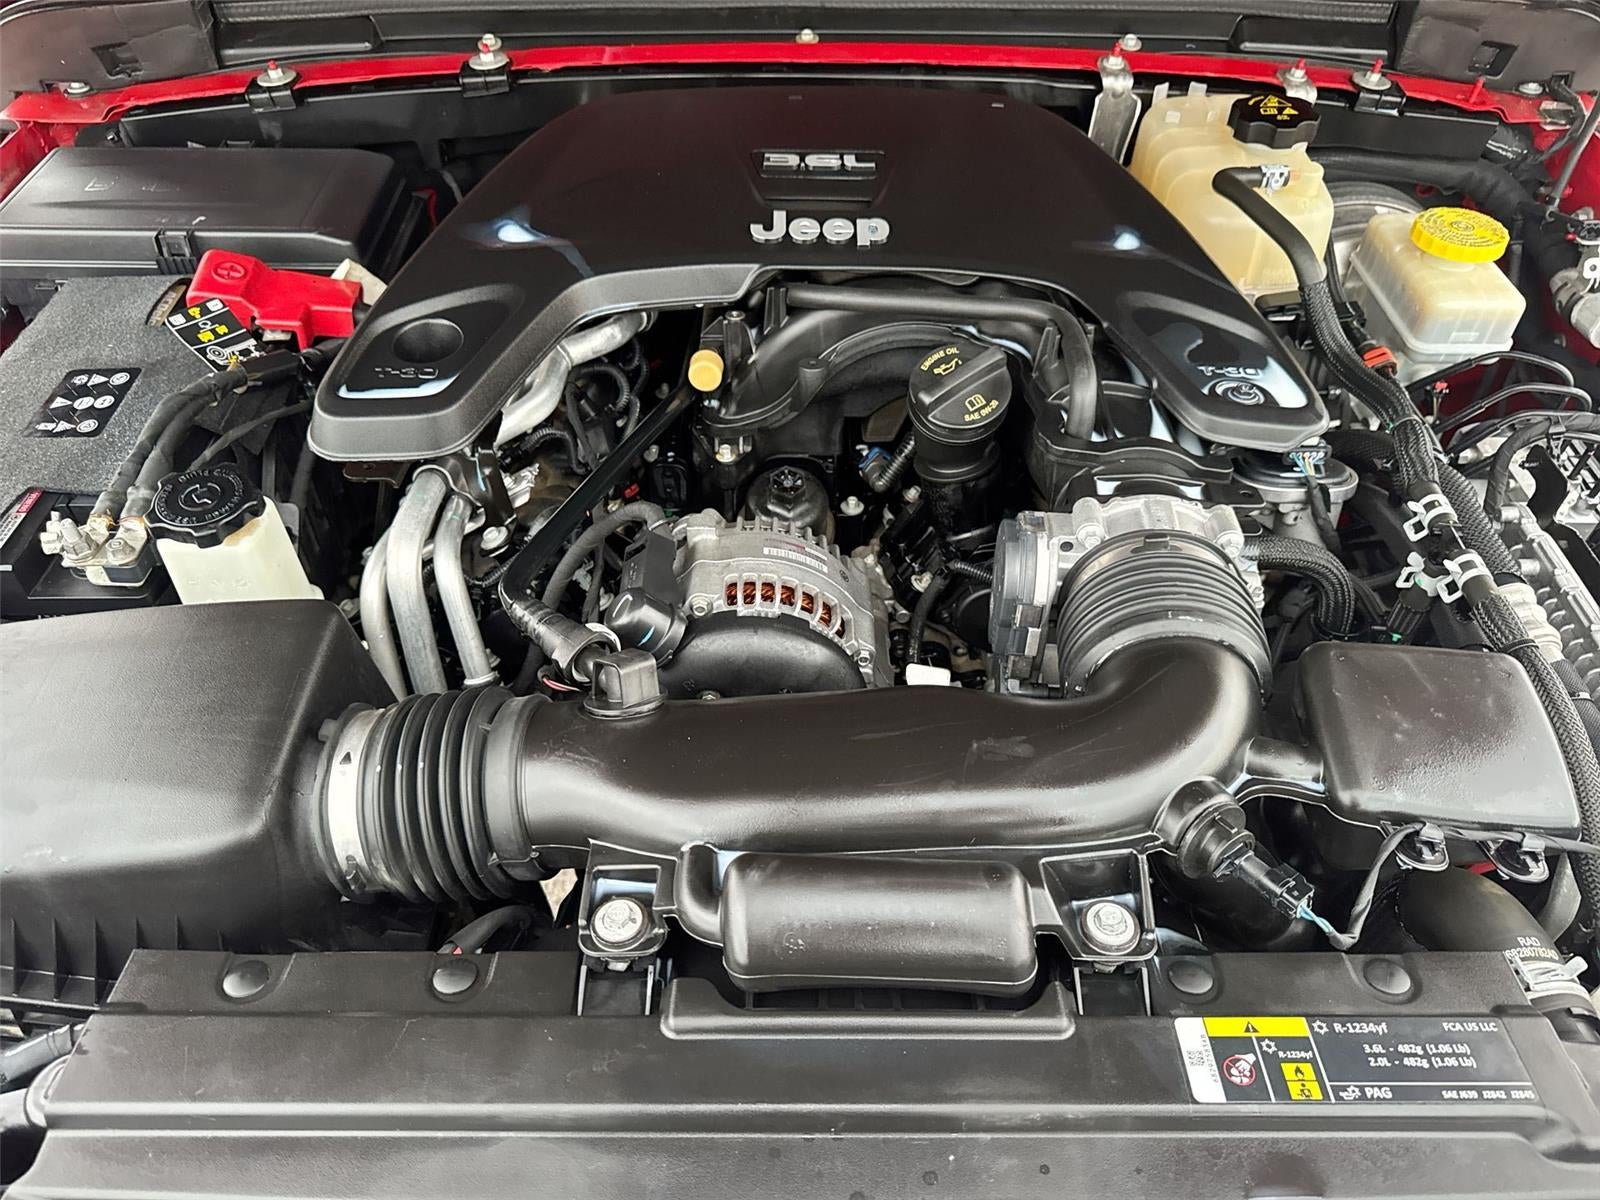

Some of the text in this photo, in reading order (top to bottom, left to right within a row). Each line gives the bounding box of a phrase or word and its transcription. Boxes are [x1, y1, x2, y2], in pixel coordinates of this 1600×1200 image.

[763, 153, 876, 171] 3.6L
[750, 210, 890, 249] Jeep
[920, 347, 960, 371] ENGINE OIL
[1516, 936, 1541, 946] RAD
[1333, 1022, 1388, 1035] R-1234yf
[1442, 1022, 1498, 1032] FCA US LLC
[1278, 1051, 1313, 1059] R-1234yf
[1363, 1044, 1386, 1053] 3.6L
[1397, 1044, 1424, 1055] 482g
[1425, 1043, 1452, 1055] (1.06
[1453, 1044, 1471, 1055] Lb)
[1368, 1057, 1392, 1067] 2.0L
[1403, 1057, 1430, 1069] 482g
[1431, 1056, 1459, 1069] (1.06
[1459, 1056, 1477, 1069] Lb)
[1364, 1087, 1393, 1099] PAG
[1441, 1090, 1459, 1099] SAE
